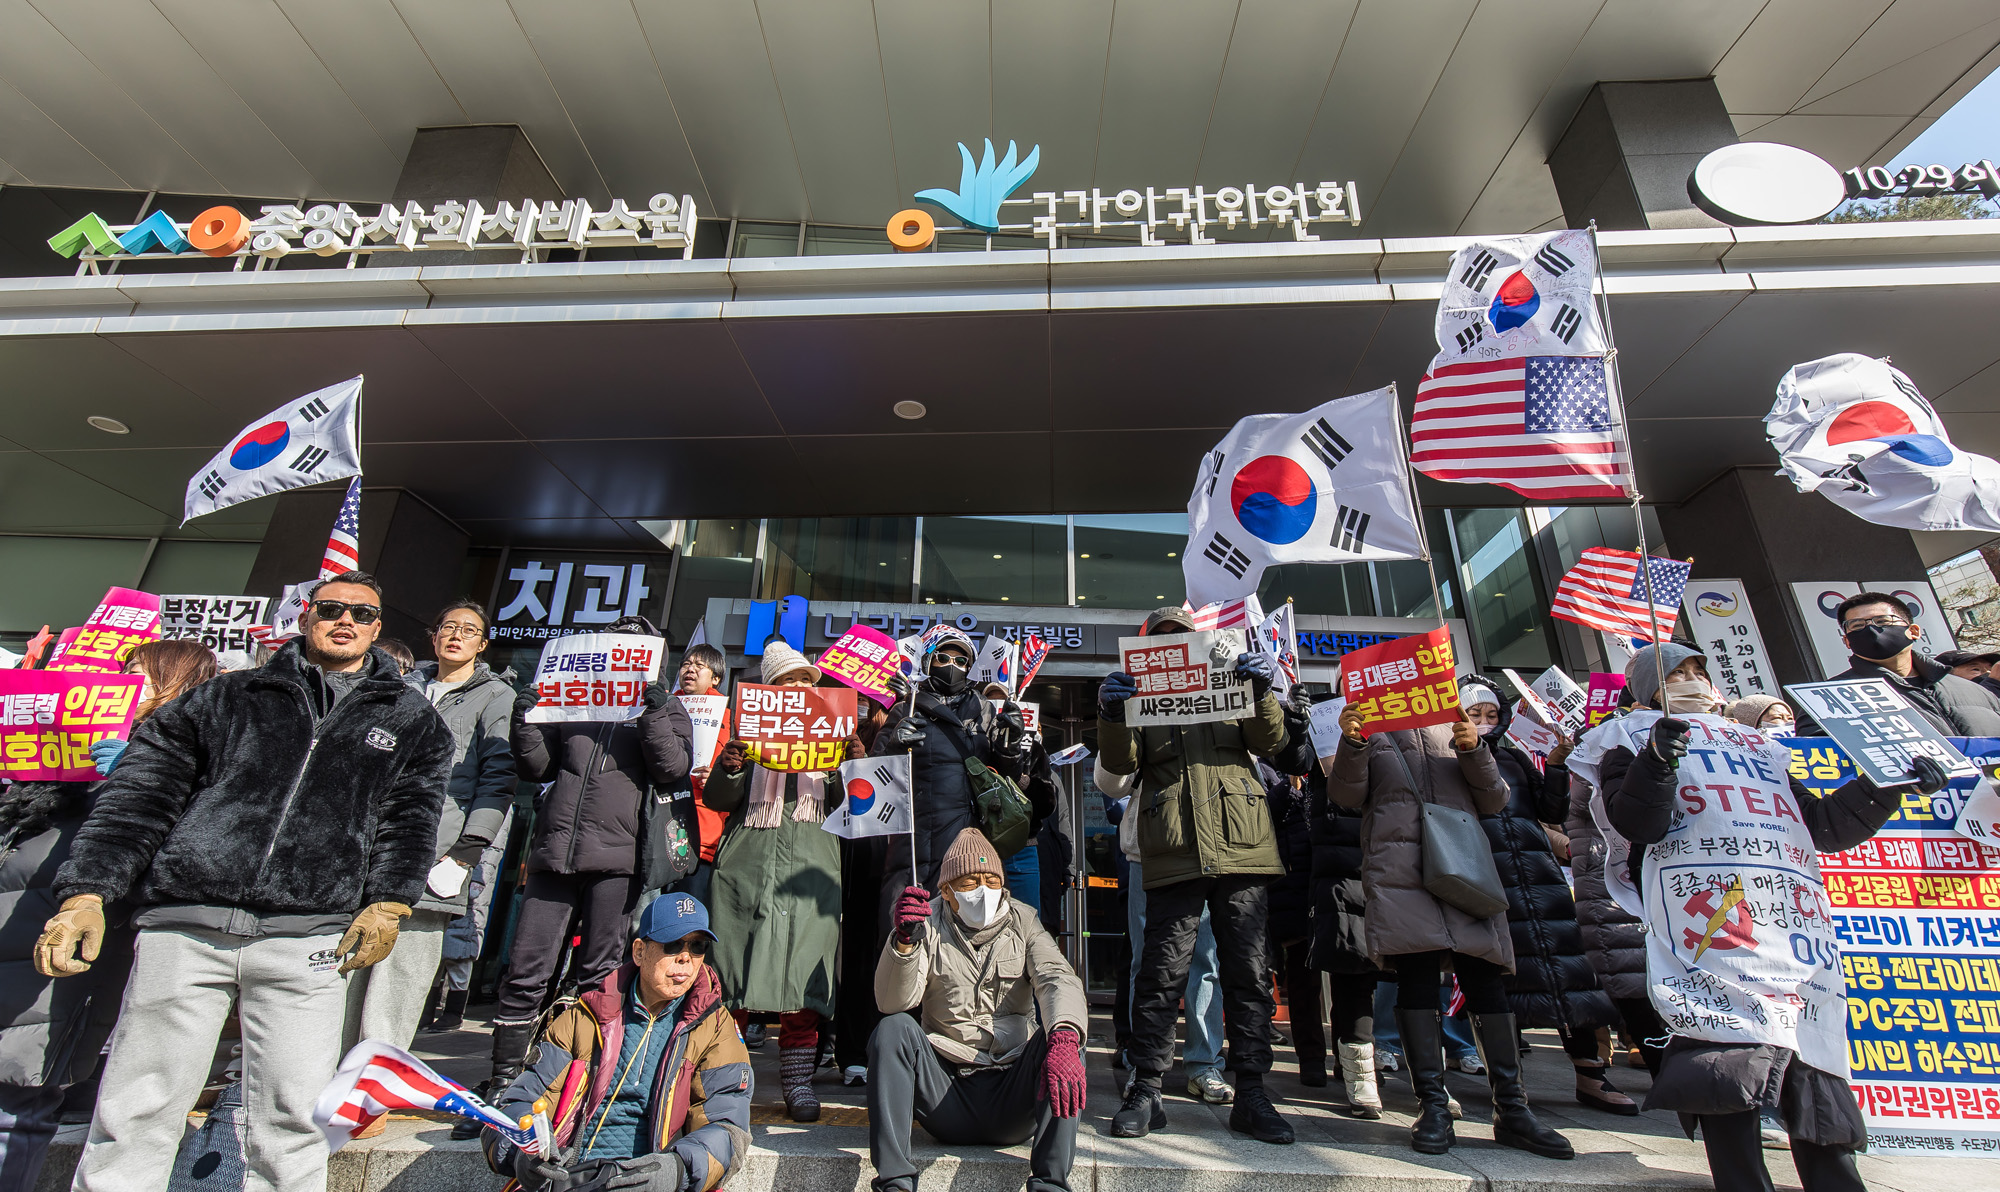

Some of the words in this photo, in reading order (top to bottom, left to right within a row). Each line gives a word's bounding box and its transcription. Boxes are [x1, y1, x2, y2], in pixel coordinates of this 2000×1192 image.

[249, 192, 698, 259] 중앙사회서비스원
[1032, 180, 1362, 249] 국가인권위원회
[498, 561, 650, 625] 치과
[164, 598, 261, 625] 부정선거
[542, 655, 557, 674] 윤
[558, 652, 608, 674] 대통령
[611, 646, 653, 673] 인권
[835, 634, 855, 648] 윤
[847, 637, 890, 664] 대통령
[1128, 647, 1186, 673] 윤석열
[1134, 667, 1206, 694] 대통령과
[1347, 670, 1364, 693] 윤
[1362, 657, 1419, 688] 대통령
[1416, 640, 1456, 677] 인권
[62, 684, 138, 726] 인권
[684, 707, 713, 715] 로부터
[740, 687, 813, 716] 방어권,
[1139, 690, 1248, 717] 싸우겠습니다
[1811, 684, 1899, 715] 계엄은
[690, 718, 719, 727] 민국을
[738, 713, 805, 739] 불구속
[810, 715, 856, 739] 수사
[1847, 714, 1924, 744] 고도의
[1688, 748, 1781, 785] THE
[1732, 820, 1755, 828] Save
[1646, 839, 1694, 863] 선관위는
[1699, 836, 1783, 861] 부정선거
[1880, 839, 1922, 868] 위해
[1923, 840, 1979, 869] 싸우다
[1738, 974, 1765, 983] Make
[1847, 997, 1950, 1033] PC주의
[1848, 1039, 1914, 1073] UN의
